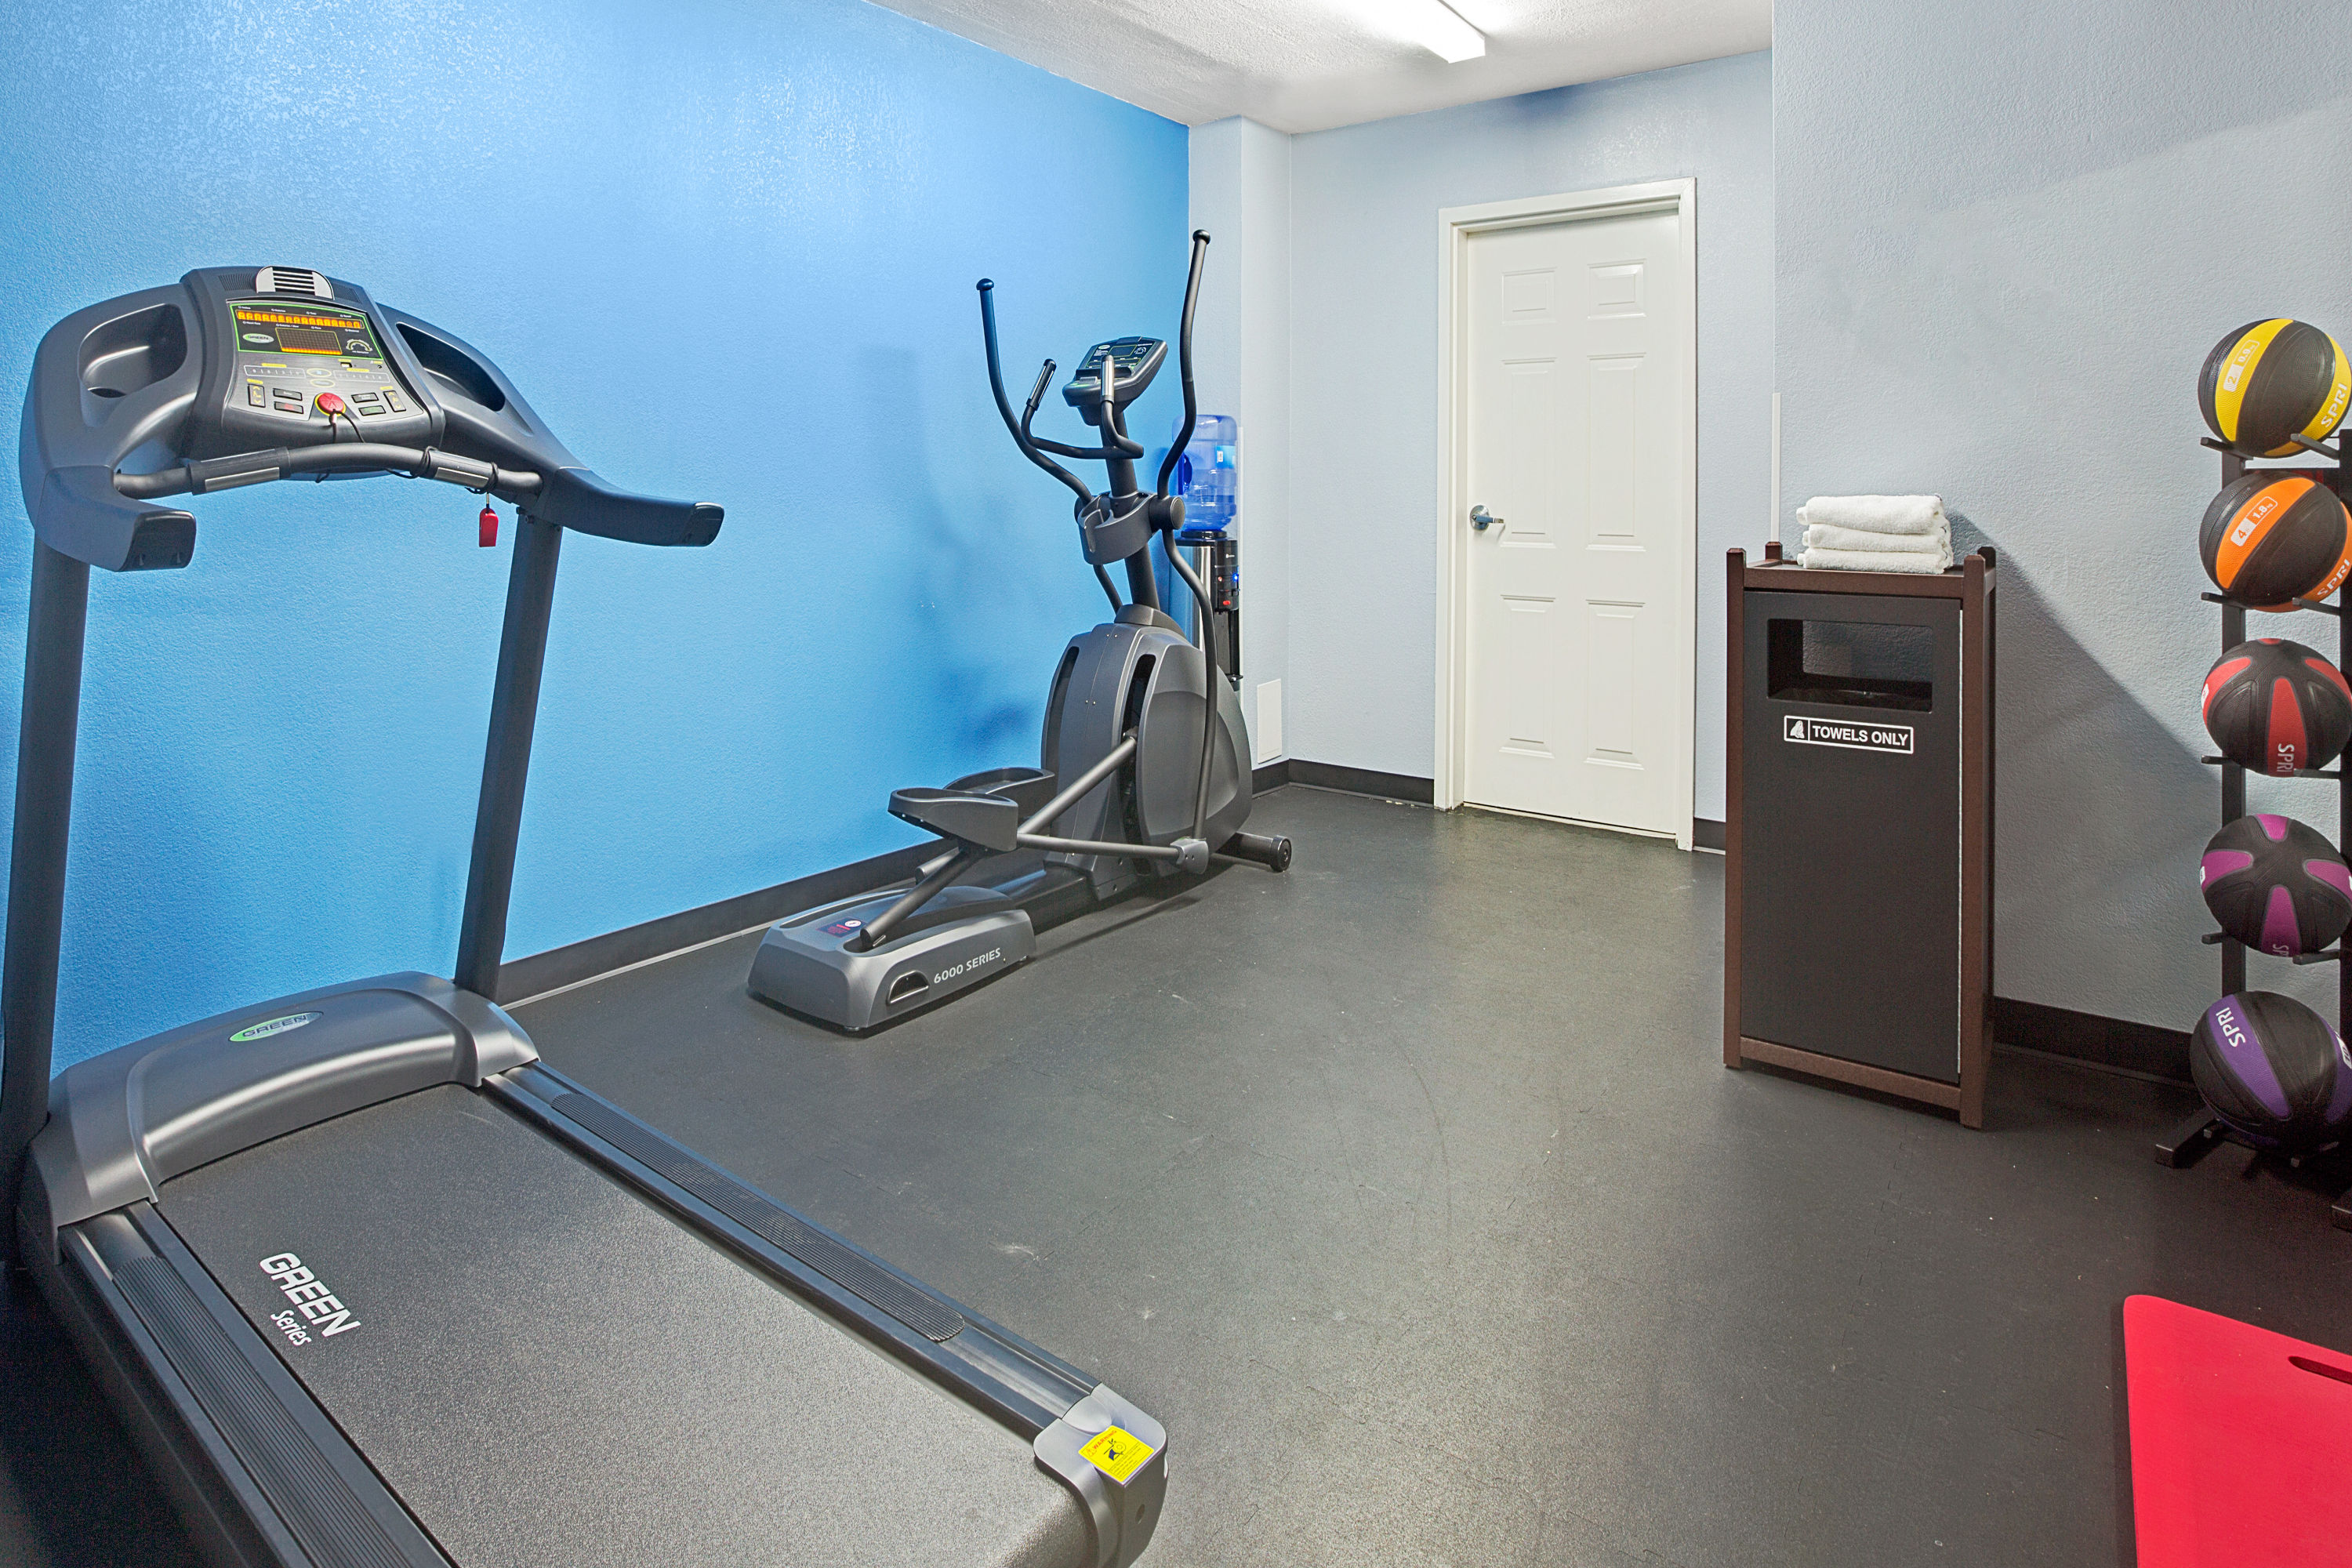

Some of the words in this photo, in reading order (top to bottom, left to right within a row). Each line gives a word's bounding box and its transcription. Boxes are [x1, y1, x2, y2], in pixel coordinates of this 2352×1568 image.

[2321, 383, 2347, 427] SPRI
[2317, 559, 2350, 596] SPRI
[1813, 725, 1868, 742] TOWELS
[1871, 731, 1908, 746] ONLY
[2276, 743, 2295, 772] SPRI
[934, 964, 964, 984] 6000
[966, 947, 1001, 971] SERIES
[243, 1014, 307, 1036] GREEN
[2216, 1007, 2246, 1047] SPRI
[260, 1252, 361, 1338] GREEN
[270, 1309, 312, 1346] Series
[1093, 1430, 1117, 1450] WARNING
